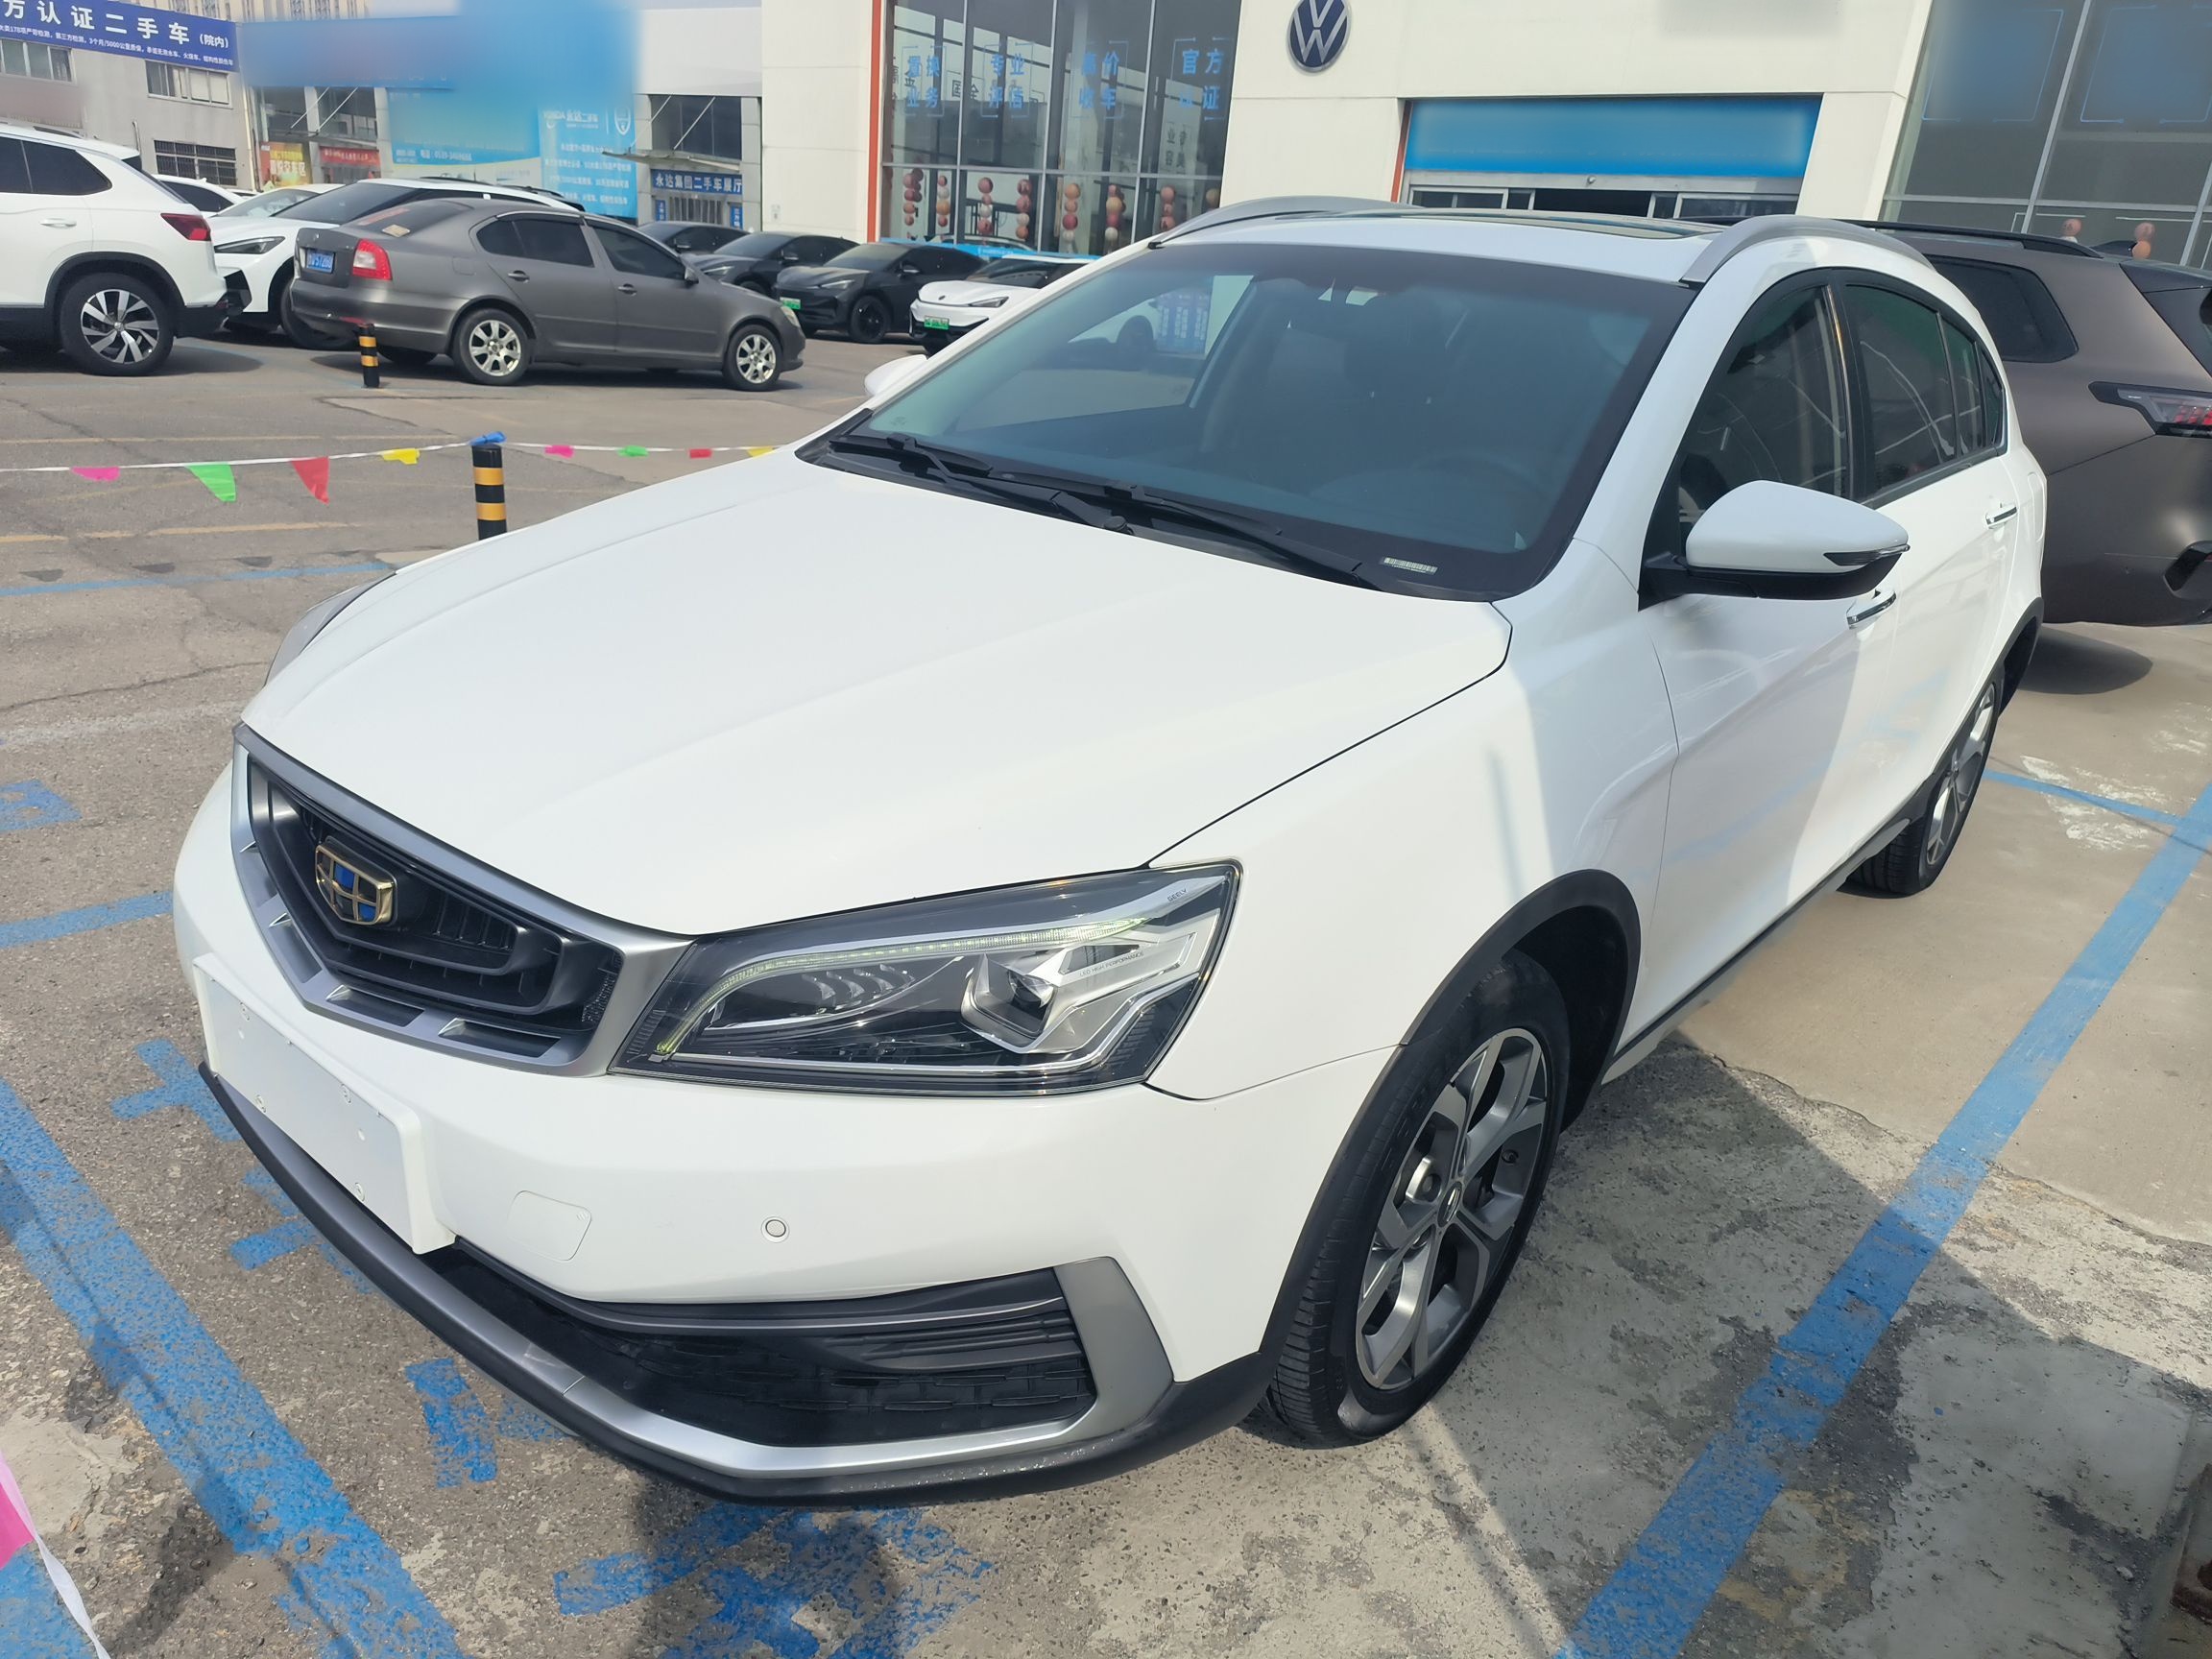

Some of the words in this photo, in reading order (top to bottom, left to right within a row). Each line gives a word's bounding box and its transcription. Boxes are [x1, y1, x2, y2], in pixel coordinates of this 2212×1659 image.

[991, 53, 1024, 77] 专业
[1182, 48, 1224, 75] 官方
[1166, 888, 1187, 902] GEELY
